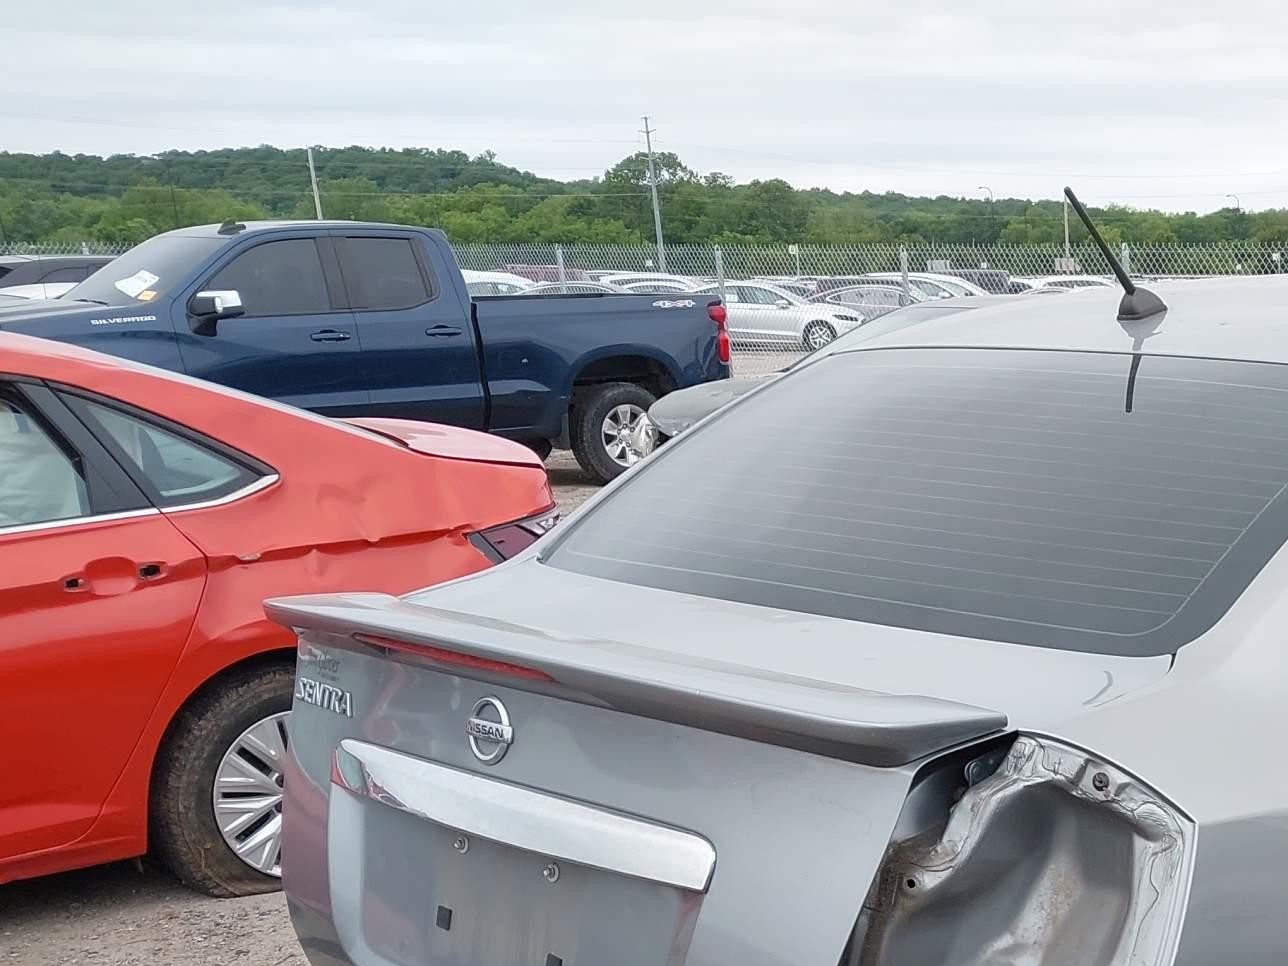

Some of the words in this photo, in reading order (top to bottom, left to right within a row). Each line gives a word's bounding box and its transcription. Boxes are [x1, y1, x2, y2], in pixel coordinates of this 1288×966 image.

[90, 315, 157, 326] SILVERADO
[296, 677, 353, 718] SENTRA
[466, 720, 504, 739] NISSAN
